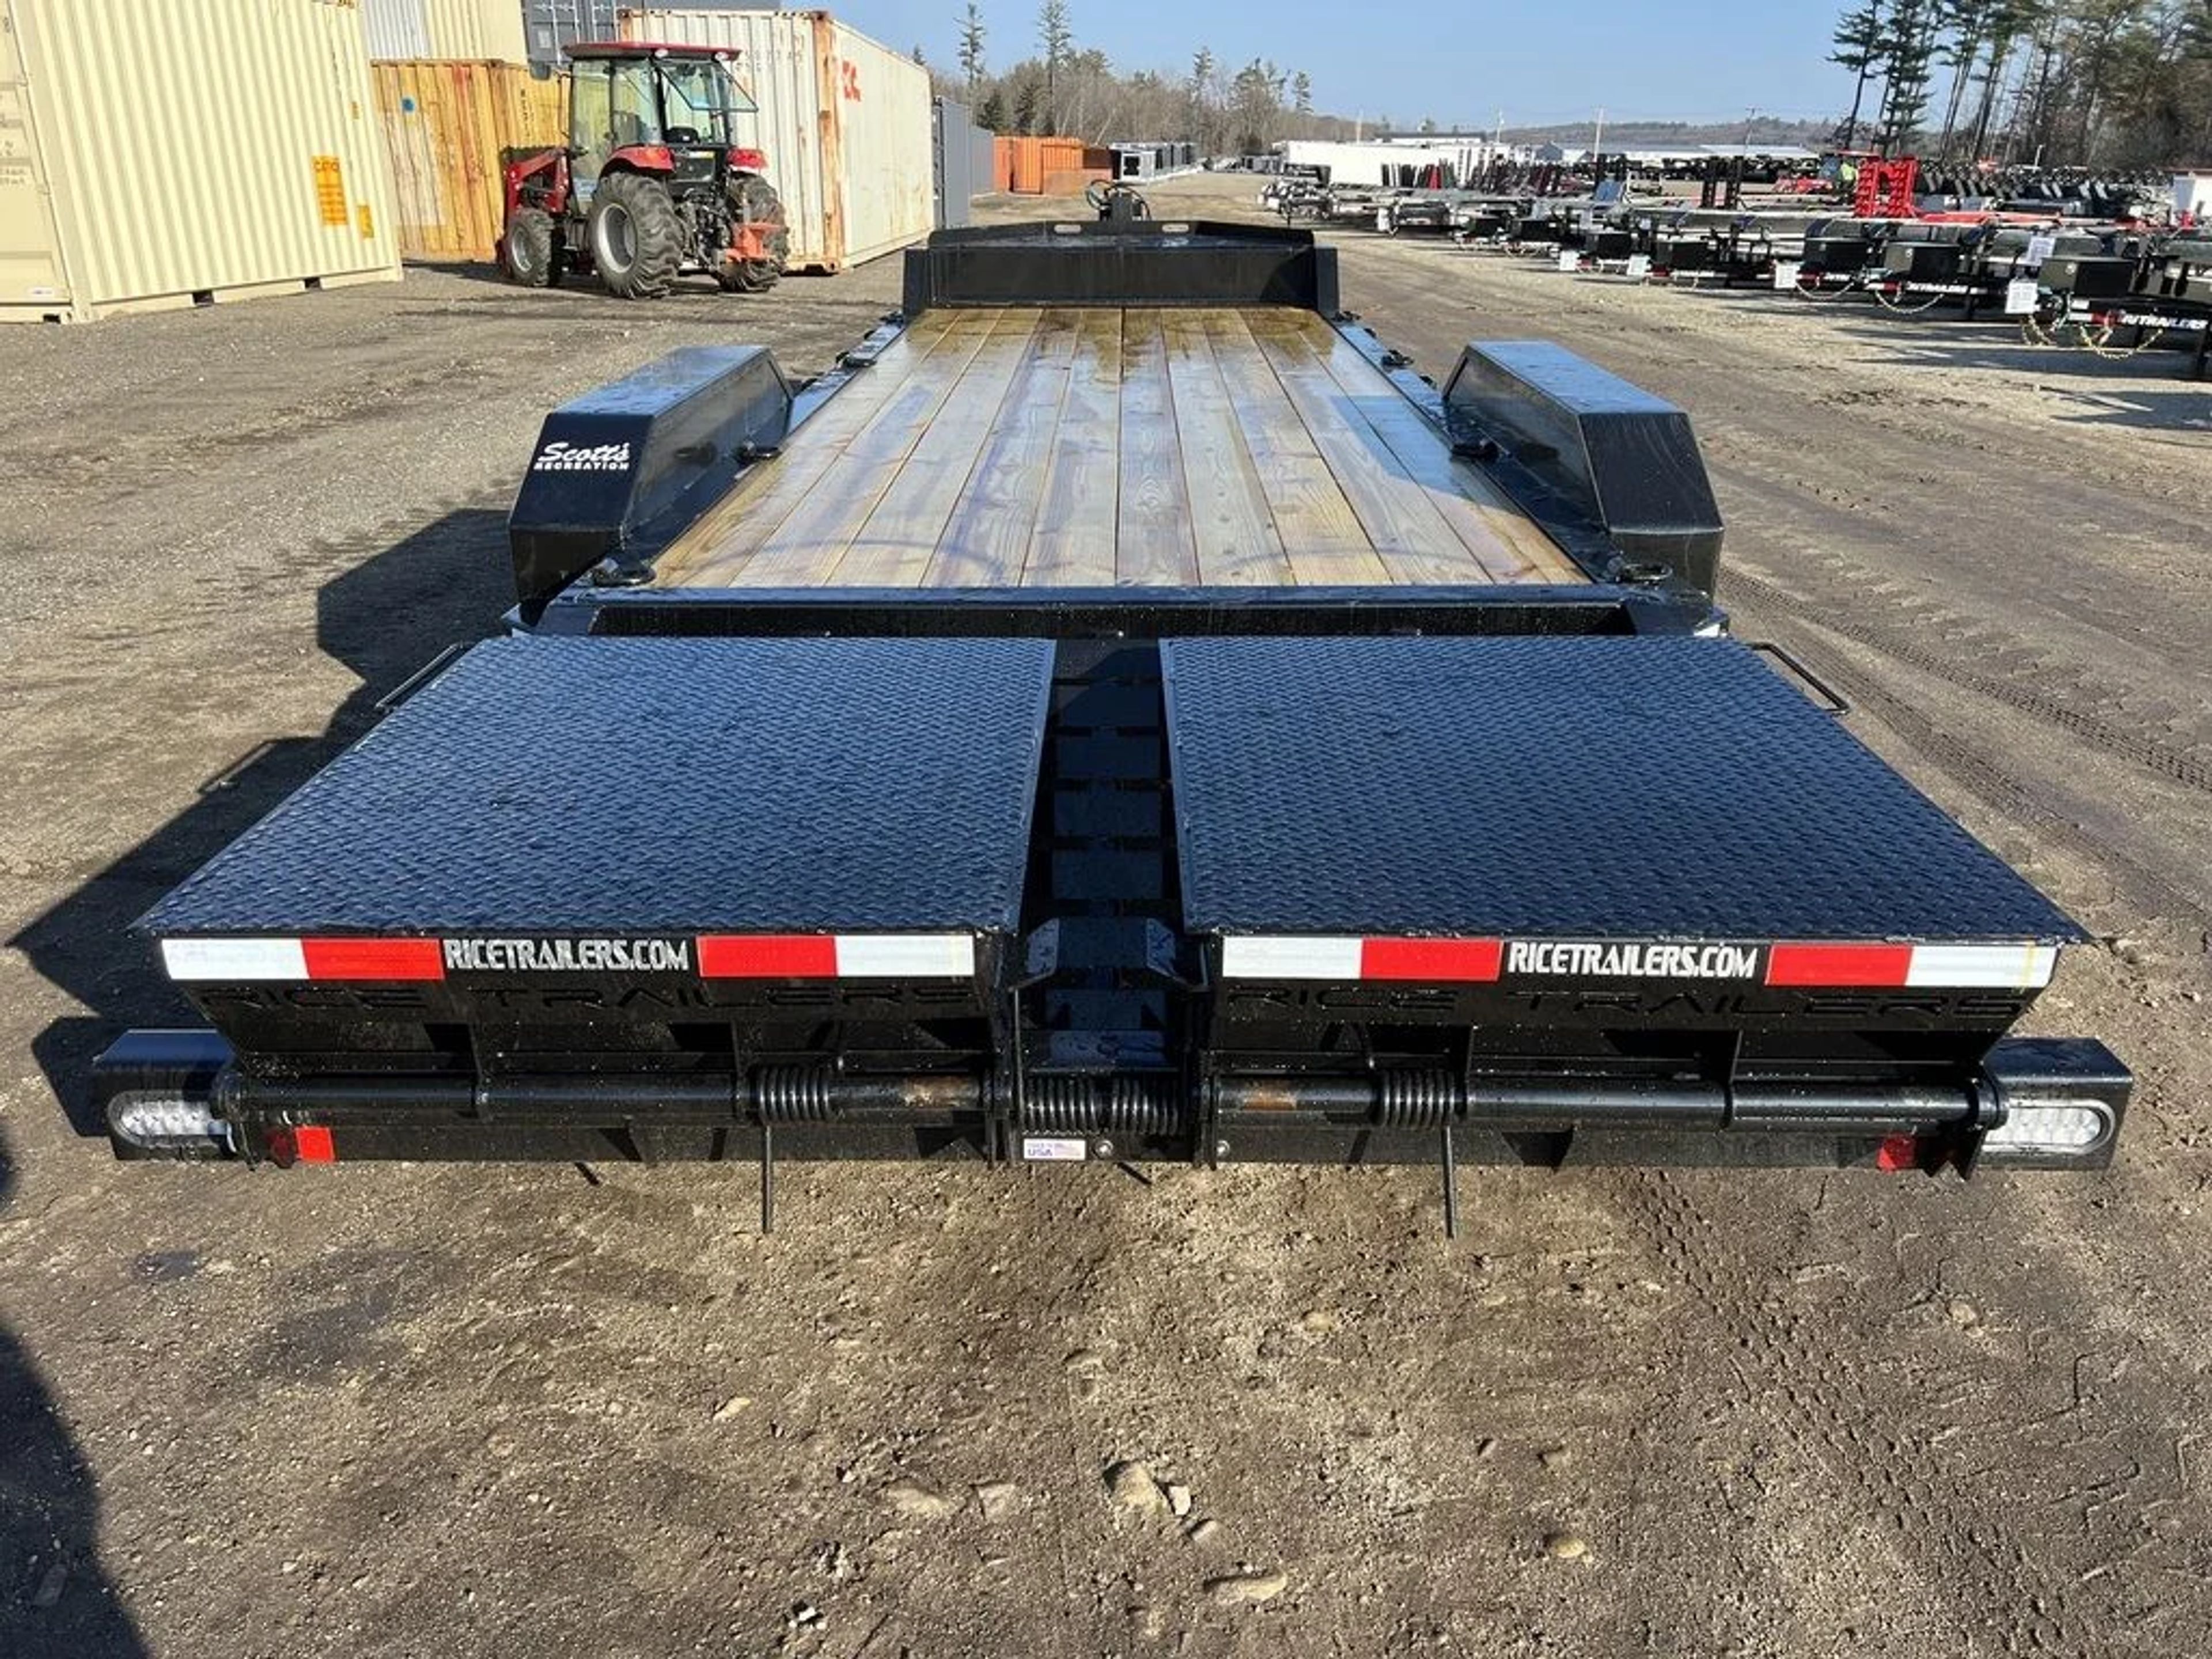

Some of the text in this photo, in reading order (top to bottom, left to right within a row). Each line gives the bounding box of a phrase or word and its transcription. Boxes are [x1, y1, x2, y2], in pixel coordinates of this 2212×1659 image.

[533, 462, 629, 470] RECREATION
[443, 940, 689, 970] RICETRAILERS.COM
[1508, 942, 1757, 978] RICETRAILERS.COM
[199, 987, 971, 1007] RICE TRAILERS
[1227, 986, 2024, 1017] RICE TRAILERS
